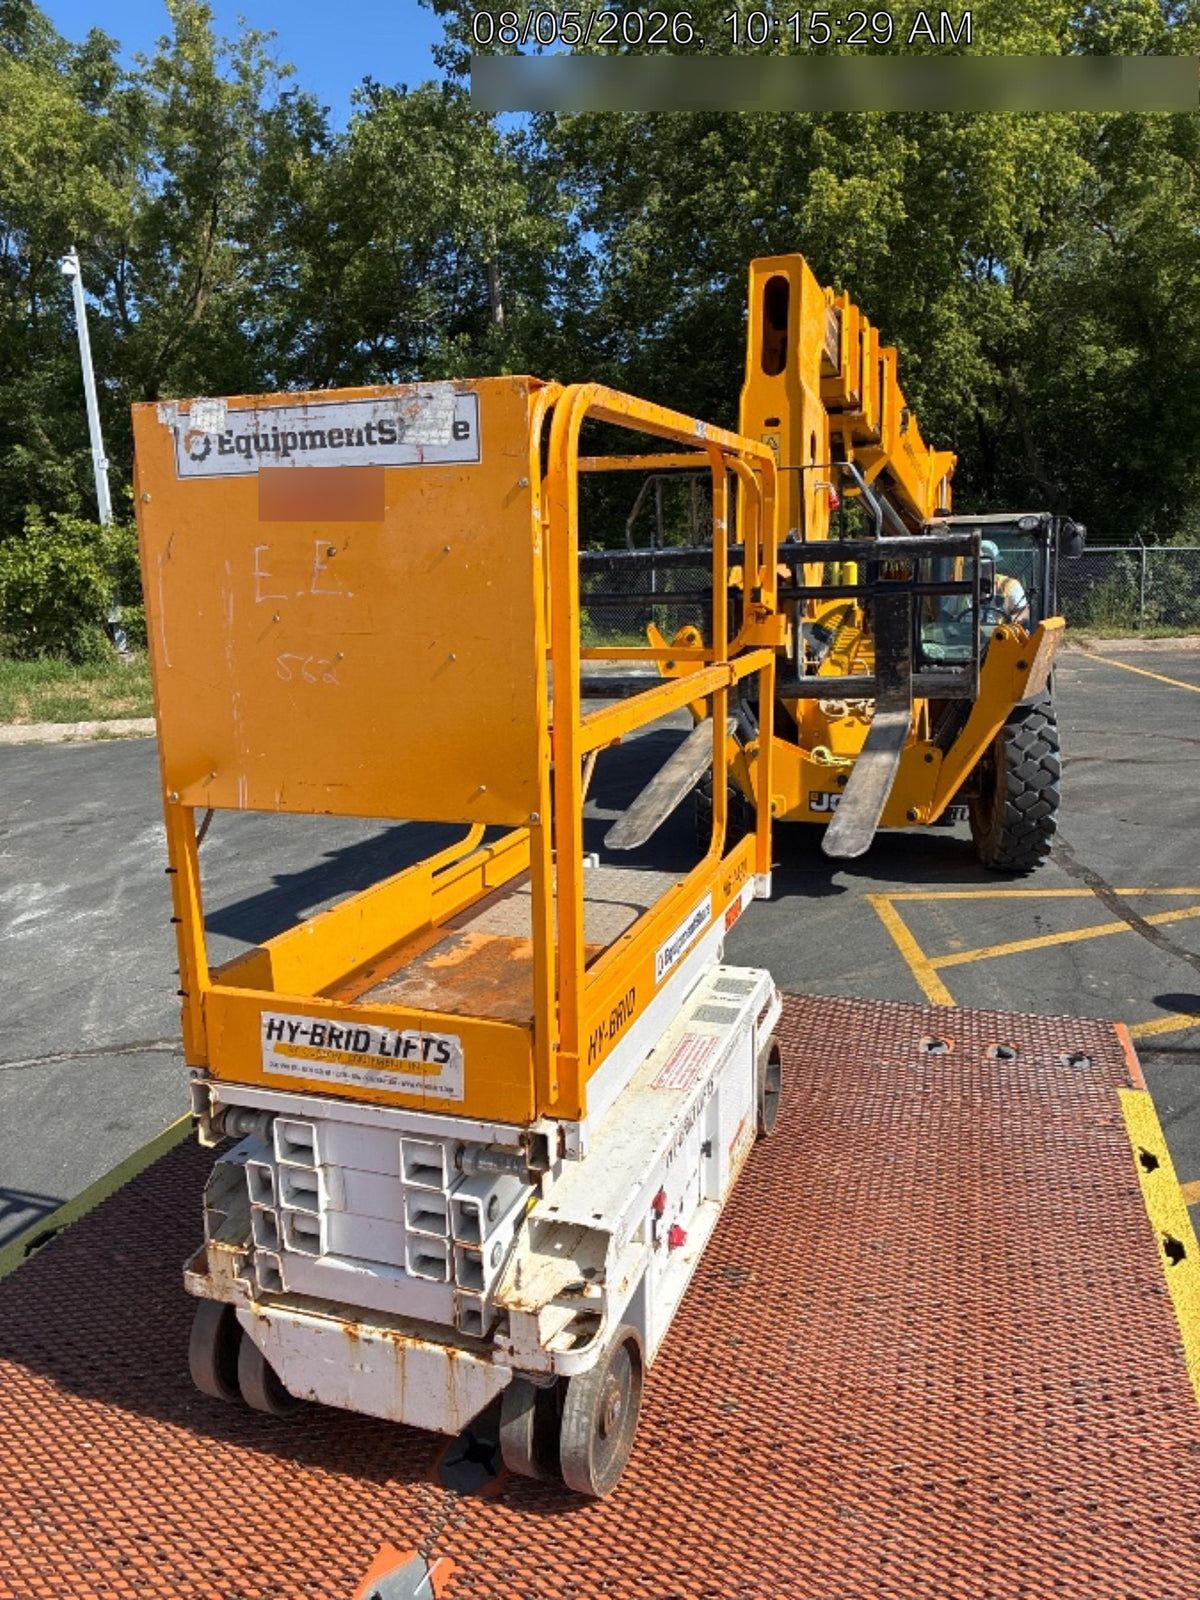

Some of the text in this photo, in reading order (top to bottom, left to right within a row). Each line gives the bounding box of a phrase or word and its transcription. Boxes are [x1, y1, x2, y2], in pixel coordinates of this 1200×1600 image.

[265, 1017, 371, 1054] HY-BRID
[377, 1031, 452, 1065] LIFTS
[587, 986, 636, 1067] HY-BRID
